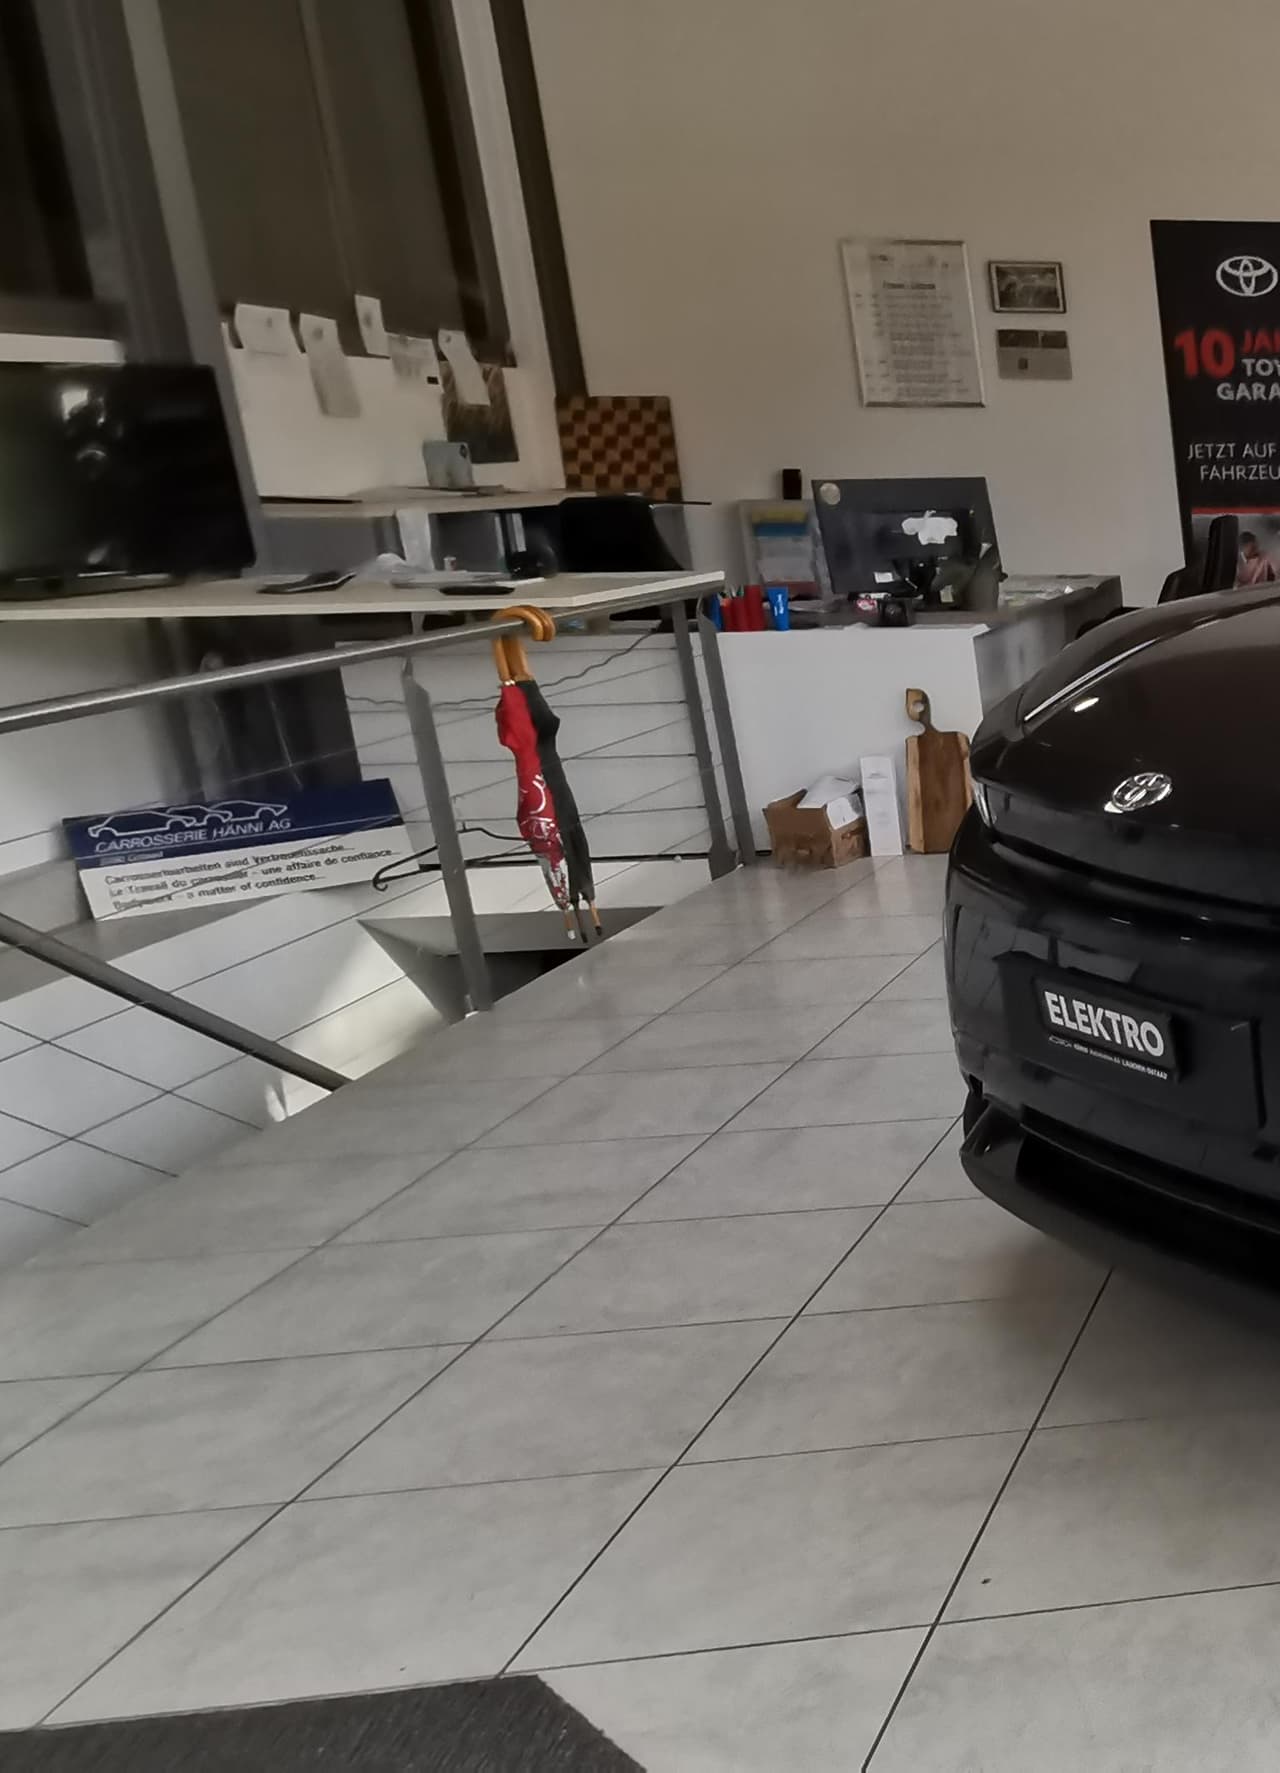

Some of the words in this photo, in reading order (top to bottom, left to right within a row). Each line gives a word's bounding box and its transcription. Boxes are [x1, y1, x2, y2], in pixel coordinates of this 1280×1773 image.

[1174, 328, 1237, 378] 10
[1187, 442, 1236, 461] JETZT
[1241, 442, 1277, 459] AUF
[95, 829, 208, 853] CARROSSERIE
[268, 817, 292, 831] AG
[1044, 991, 1165, 1057] ELEKTRO
